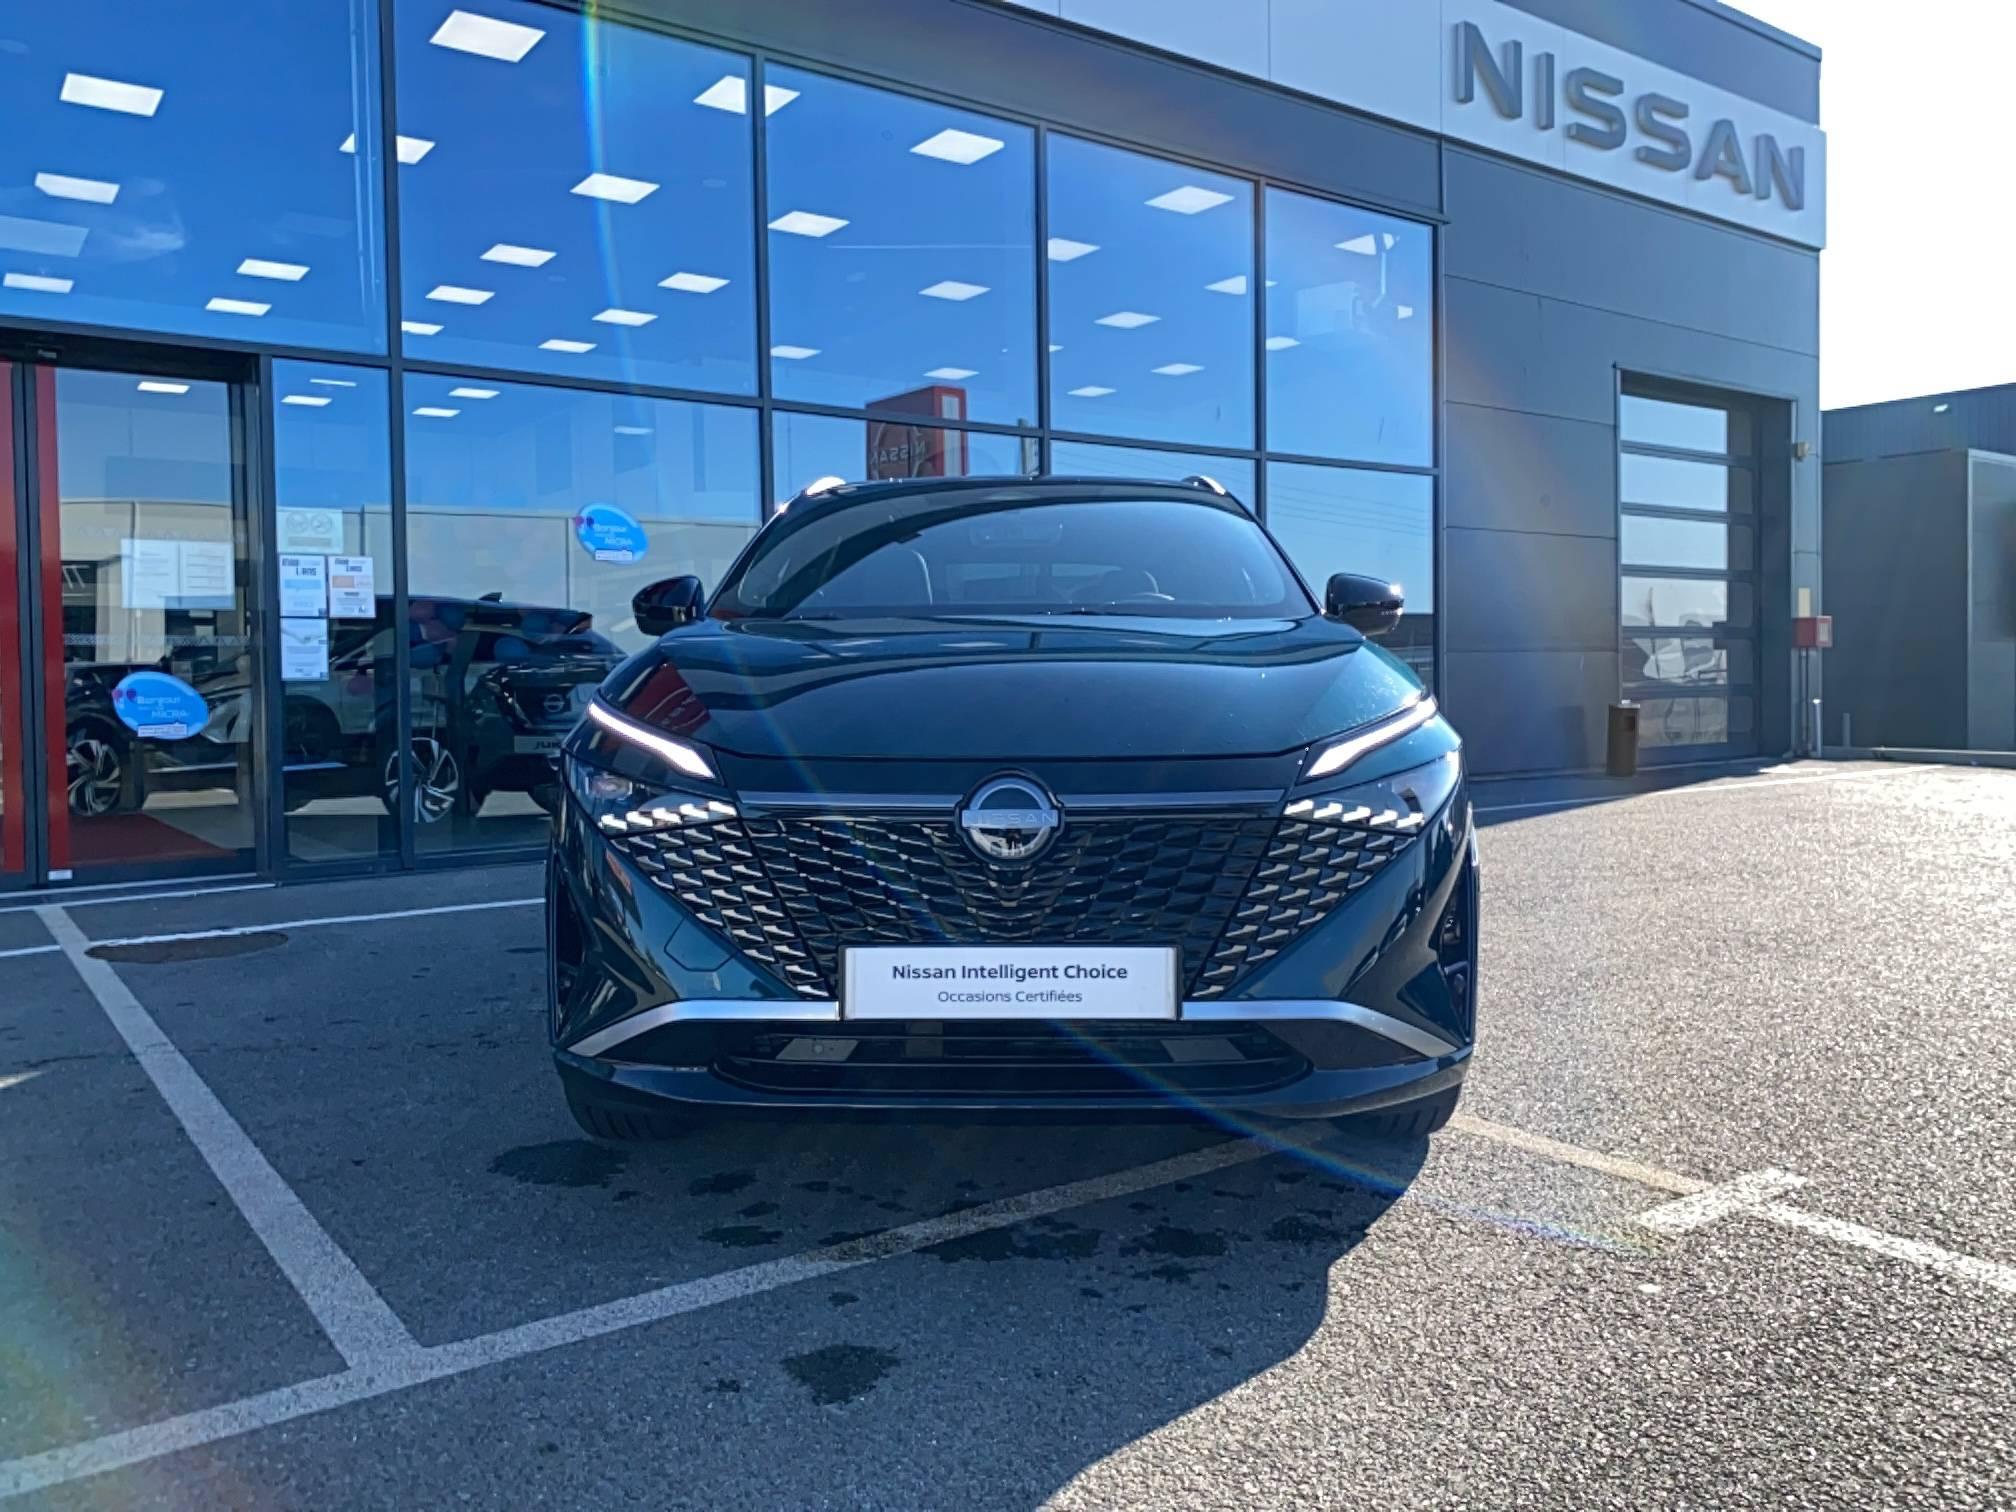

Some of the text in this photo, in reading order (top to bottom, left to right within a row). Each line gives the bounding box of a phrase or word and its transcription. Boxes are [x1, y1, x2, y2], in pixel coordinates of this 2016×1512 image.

[1455, 20, 1804, 211] NISSAN
[534, 741, 560, 750] JUK
[892, 964, 1128, 982] Nissan Intelligent Choice
[938, 990, 1083, 1002] Occasions Certifiées
